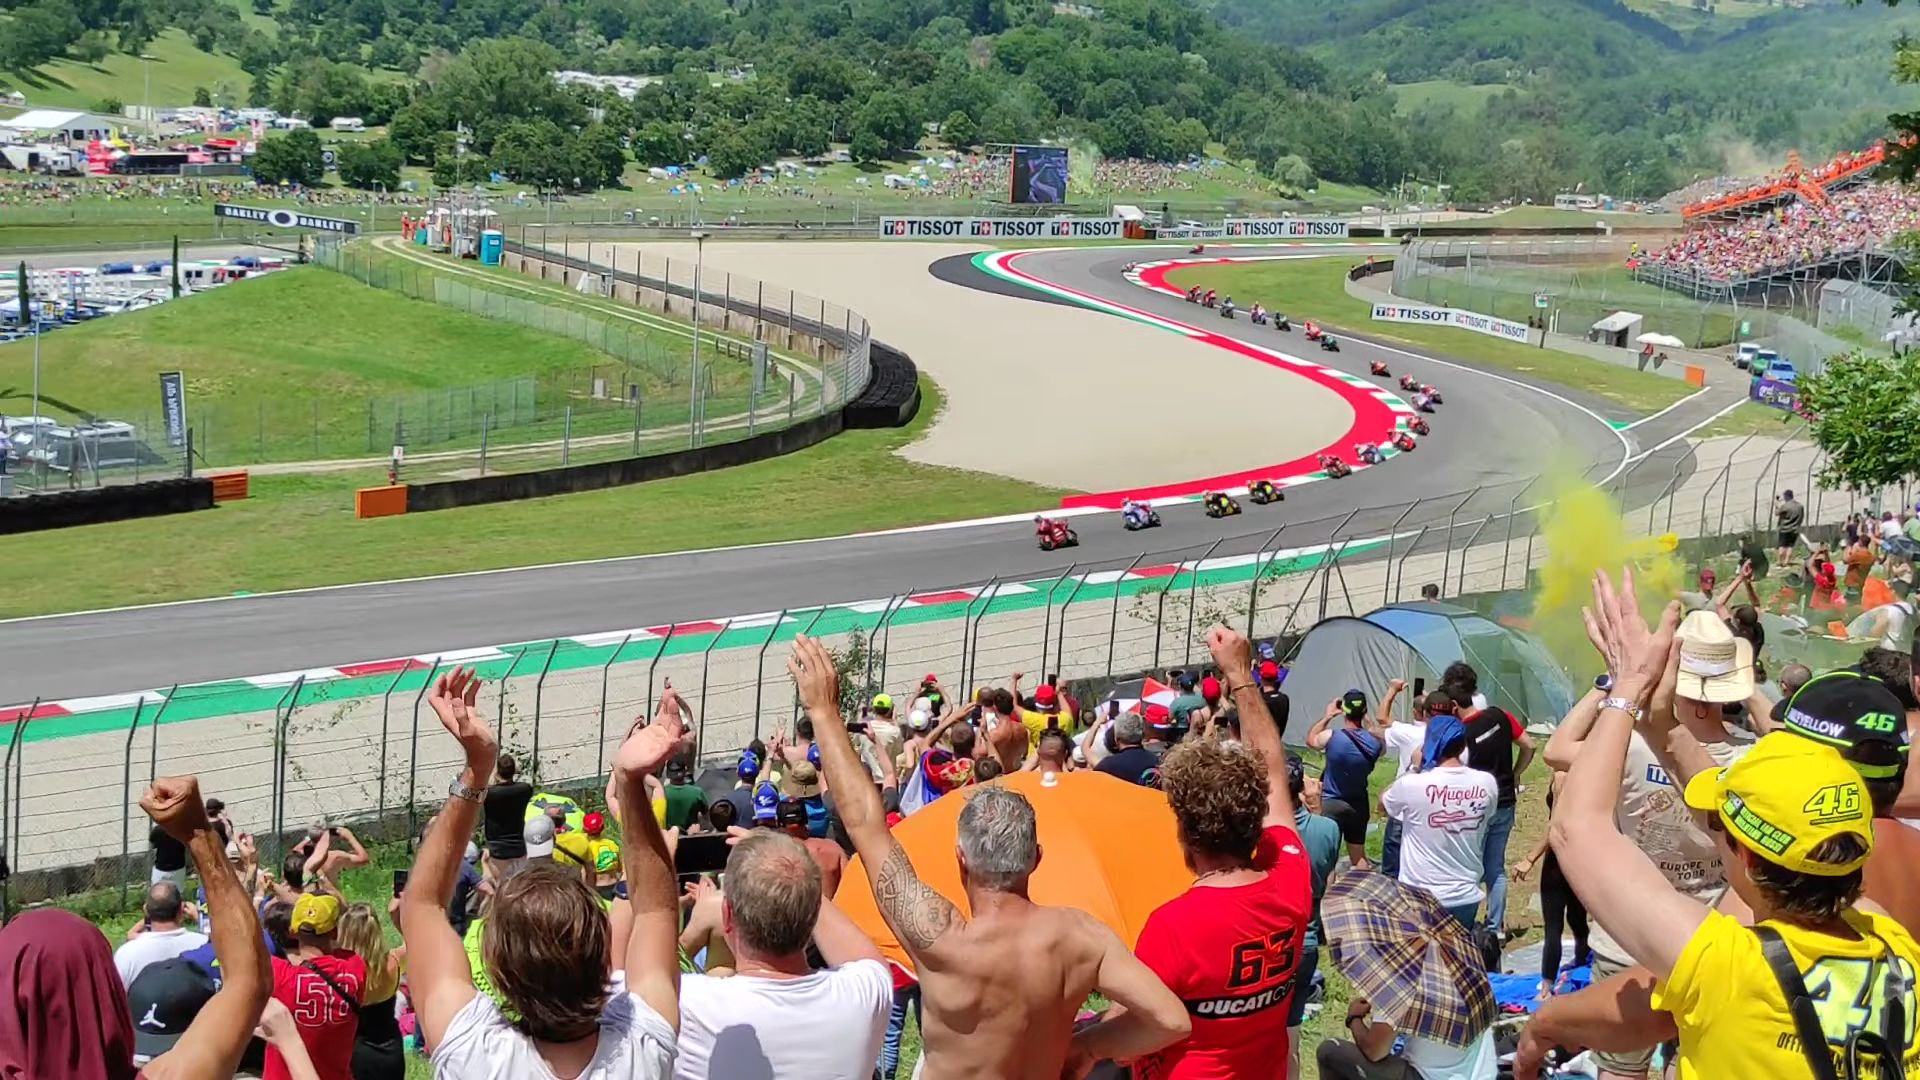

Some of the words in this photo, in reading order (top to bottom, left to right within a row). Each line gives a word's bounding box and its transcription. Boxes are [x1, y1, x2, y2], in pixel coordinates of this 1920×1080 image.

[225, 207, 266, 220] OAKLEY
[300, 217, 343, 231] OAKLEY
[907, 220, 963, 236] TISSOT
[992, 220, 1045, 236] TISSOT
[1071, 221, 1120, 236] TISSOT
[1243, 221, 1284, 236] TISSOT
[1307, 221, 1346, 235] TISSOT
[1398, 308, 1451, 321] TISSOT
[1464, 315, 1489, 329] TISSOT
[1501, 324, 1526, 338] TISSOT
[1856, 712, 1897, 733] 46
[1425, 784, 1488, 807] Mugello
[1803, 782, 1860, 816] 46
[1224, 924, 1297, 990] 63
[1197, 990, 1273, 1015] DUCATI
